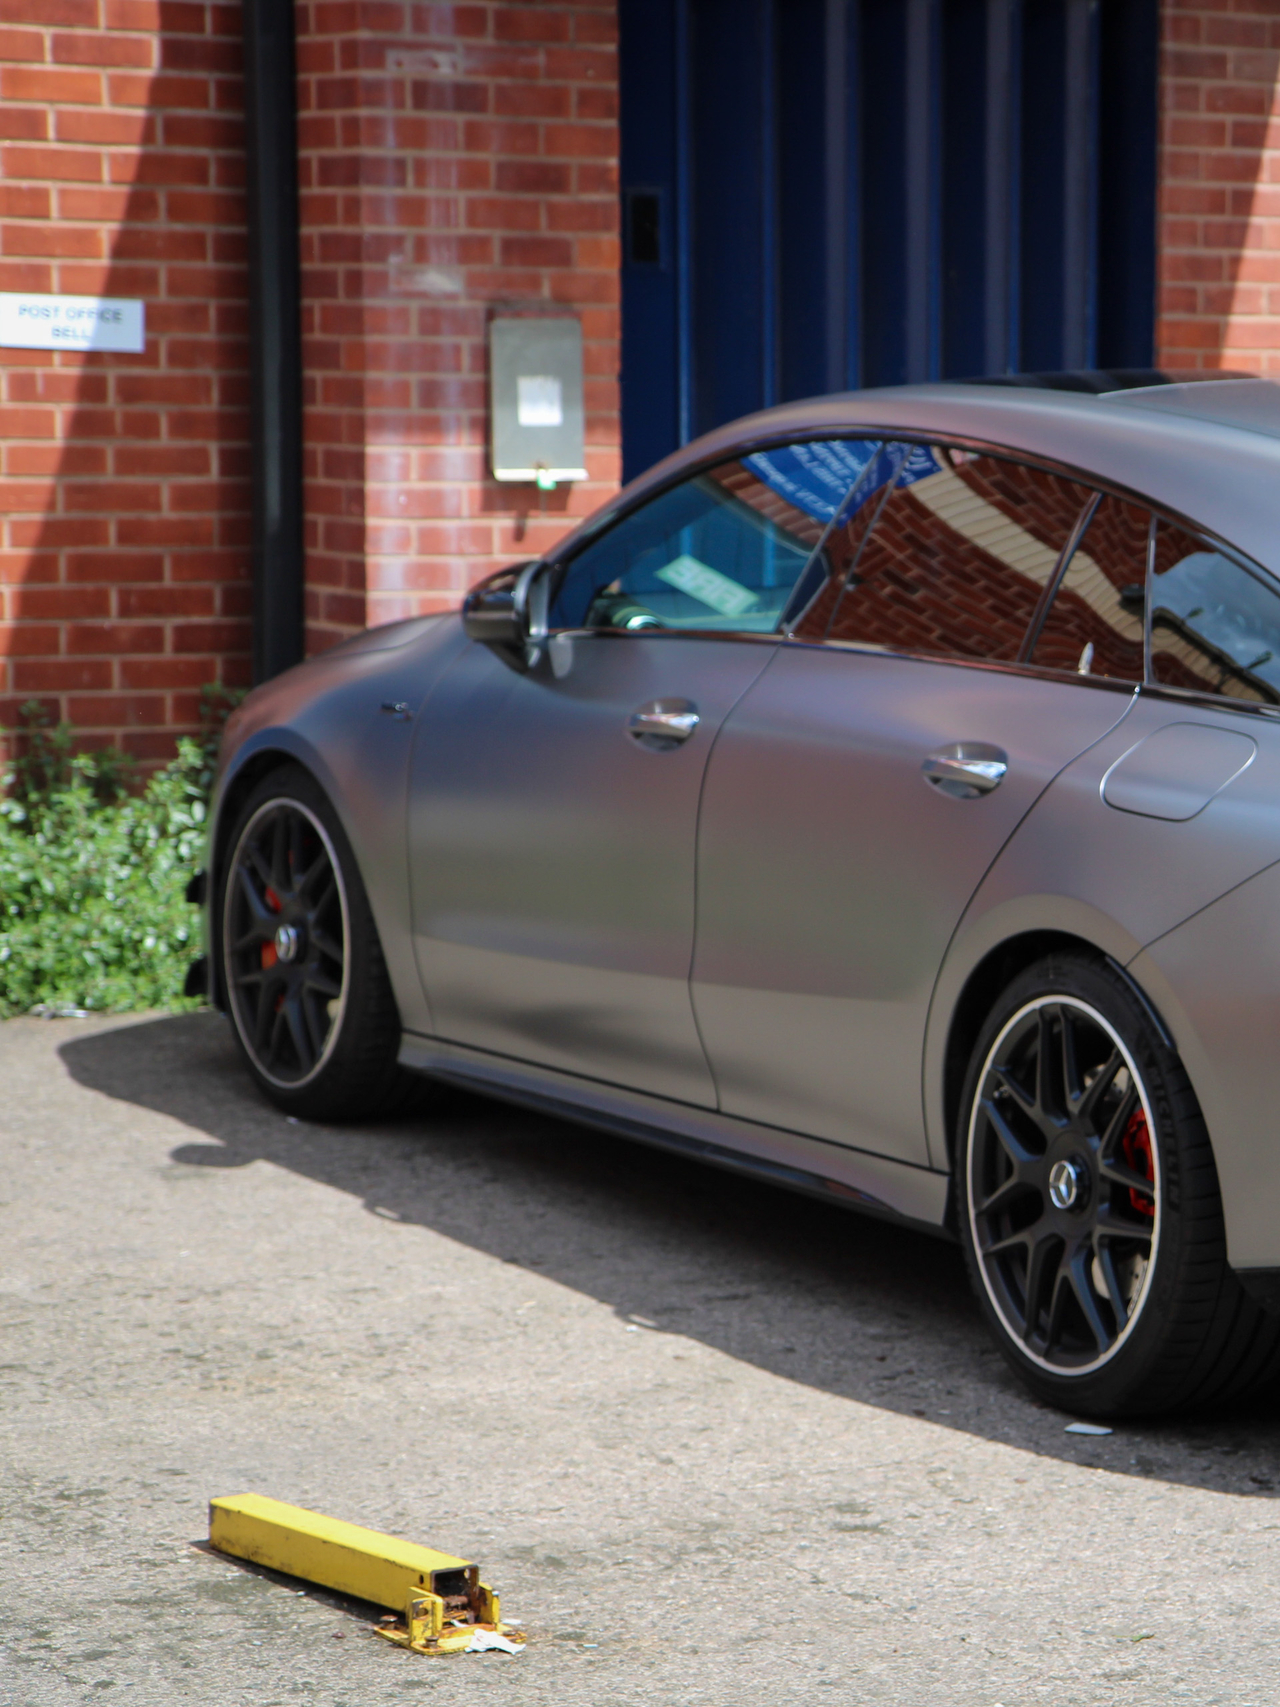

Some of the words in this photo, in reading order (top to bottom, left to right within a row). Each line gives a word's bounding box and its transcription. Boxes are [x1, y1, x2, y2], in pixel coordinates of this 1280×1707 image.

[19, 304, 61, 319] POST
[65, 306, 123, 324] OFFICE
[51, 325, 91, 340] BELL
